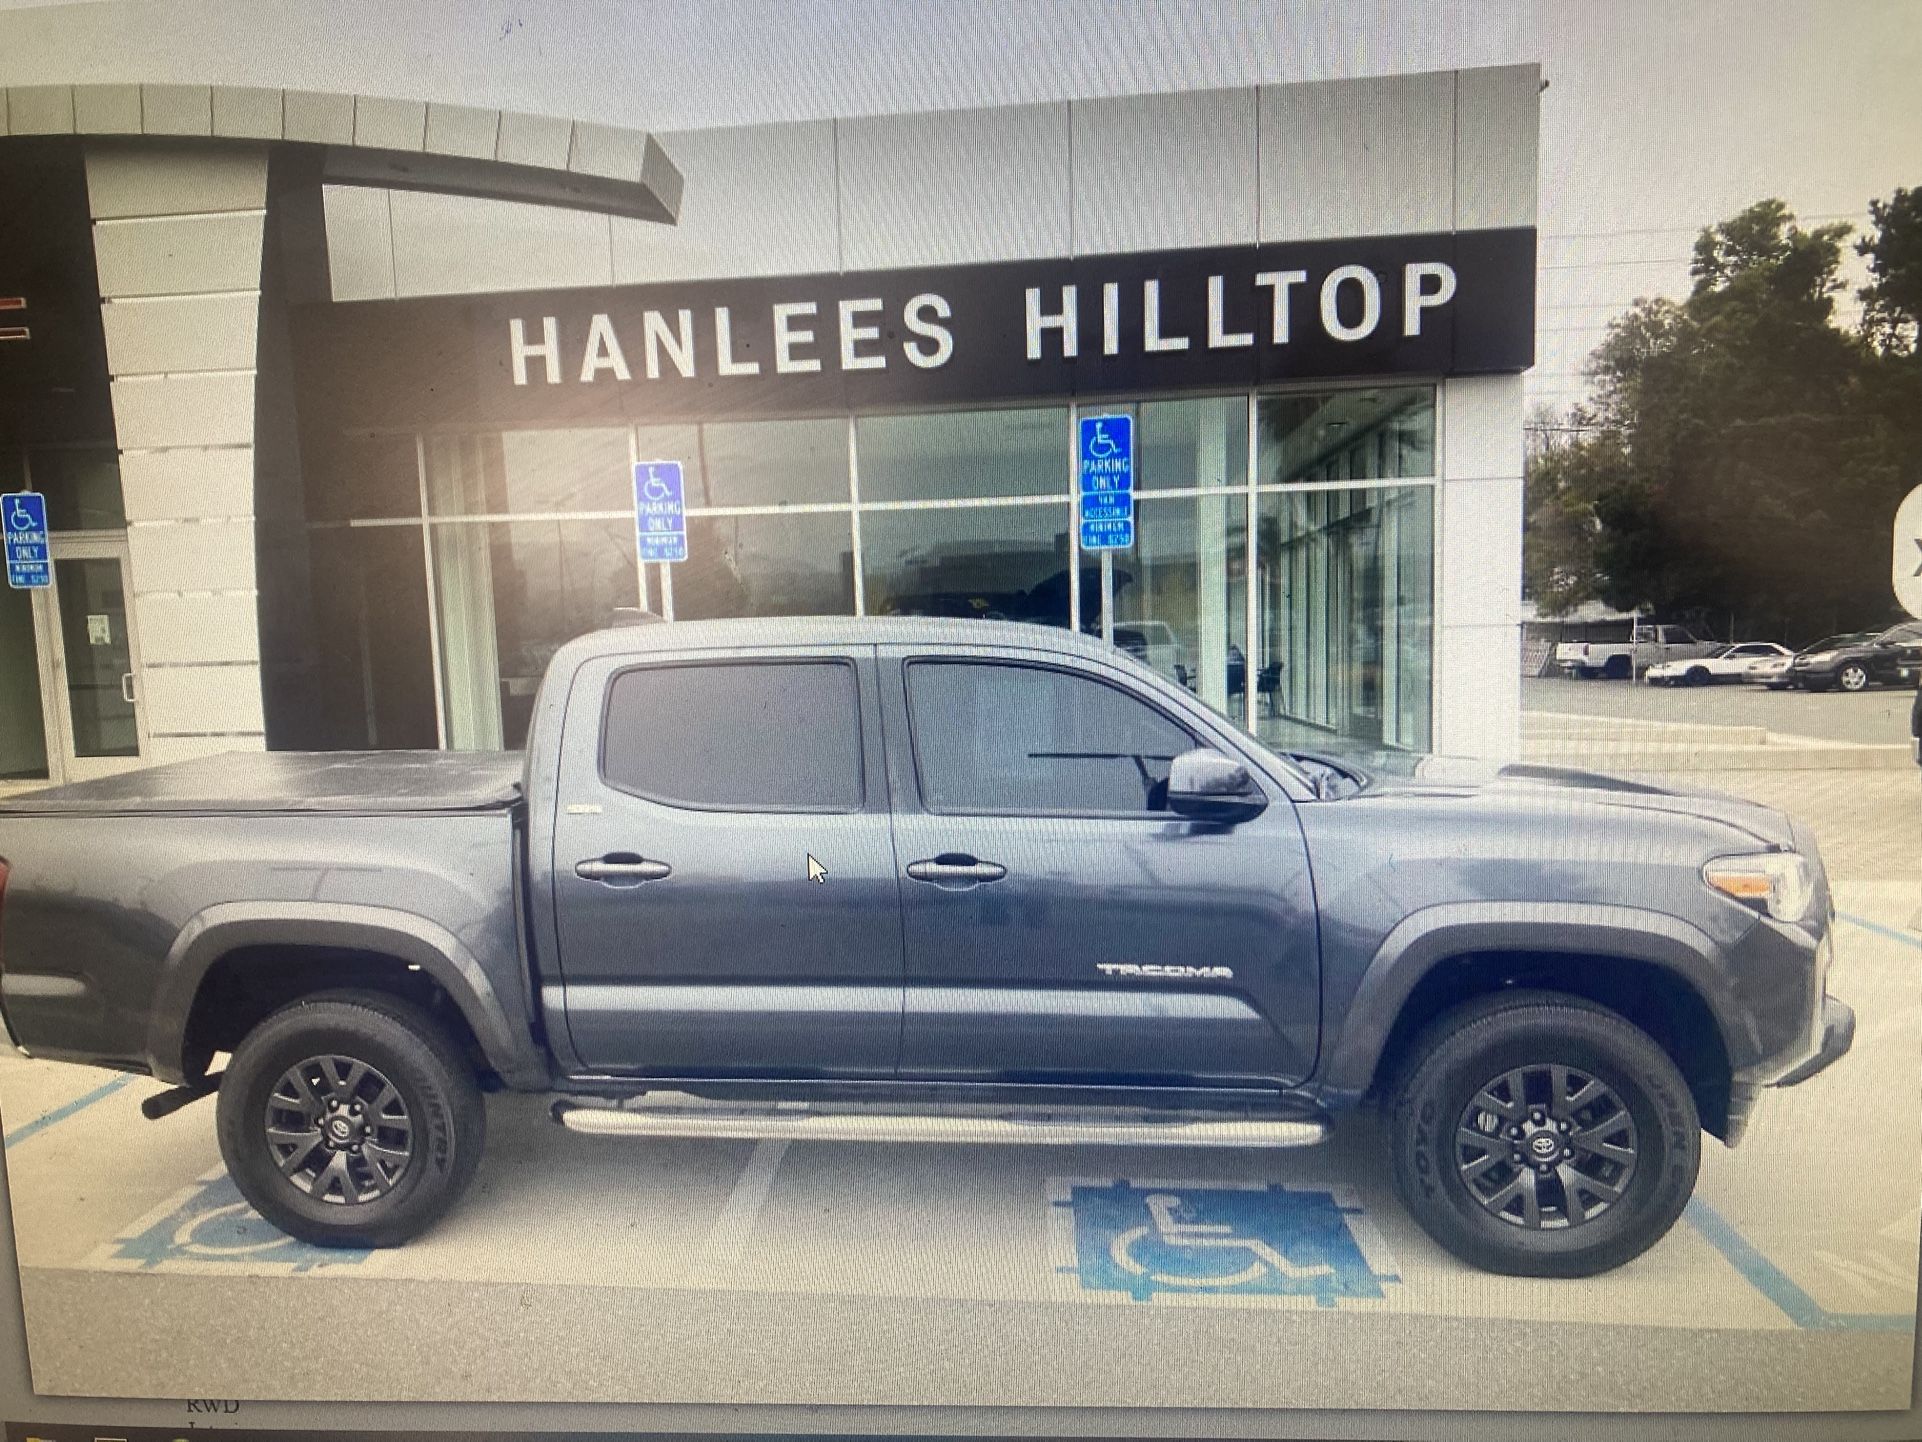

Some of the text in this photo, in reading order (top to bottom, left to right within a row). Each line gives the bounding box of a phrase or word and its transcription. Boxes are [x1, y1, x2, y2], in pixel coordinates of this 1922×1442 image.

[509, 262, 1458, 386] HANLEES HILLTOP
[1083, 458, 1129, 474] PARKING
[1091, 474, 1120, 491] ONLY
[639, 500, 681, 516] PARKING
[648, 515, 673, 532] ONLY
[7, 530, 45, 544] PARKING
[15, 545, 39, 559] ONLY
[1096, 962, 1233, 979] TACOMA
[187, 1399, 239, 1413] RWD
